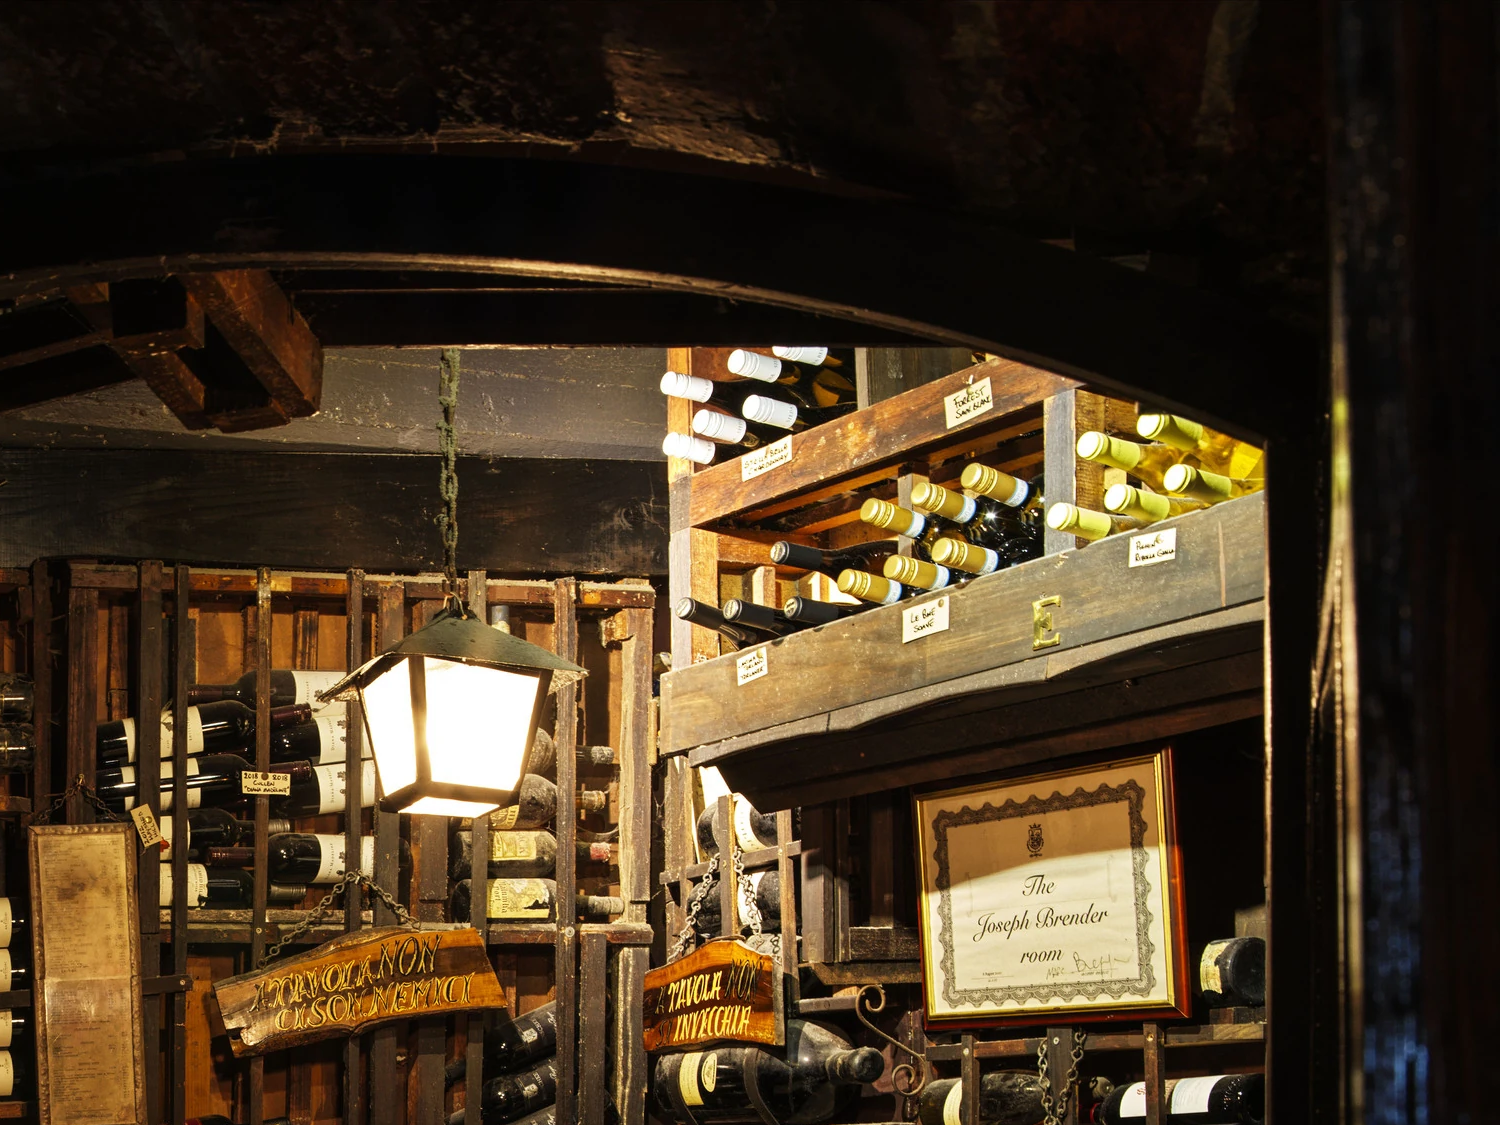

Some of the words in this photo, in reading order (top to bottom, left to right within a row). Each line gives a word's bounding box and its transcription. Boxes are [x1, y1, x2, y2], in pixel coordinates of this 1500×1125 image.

[1032, 595, 1062, 651] E
[1022, 874, 1055, 897] The
[972, 908, 1031, 942] Joseph
[1035, 902, 1108, 929] Brender
[376, 933, 444, 982] NON
[1019, 949, 1063, 964] room
[367, 971, 477, 1019] NEMICI
[655, 986, 666, 1014] A
[667, 970, 723, 1013] TAVOLA
[724, 957, 765, 1004] NON
[655, 1020, 672, 1046] SI
[673, 1004, 752, 1042] INVECCHIA
